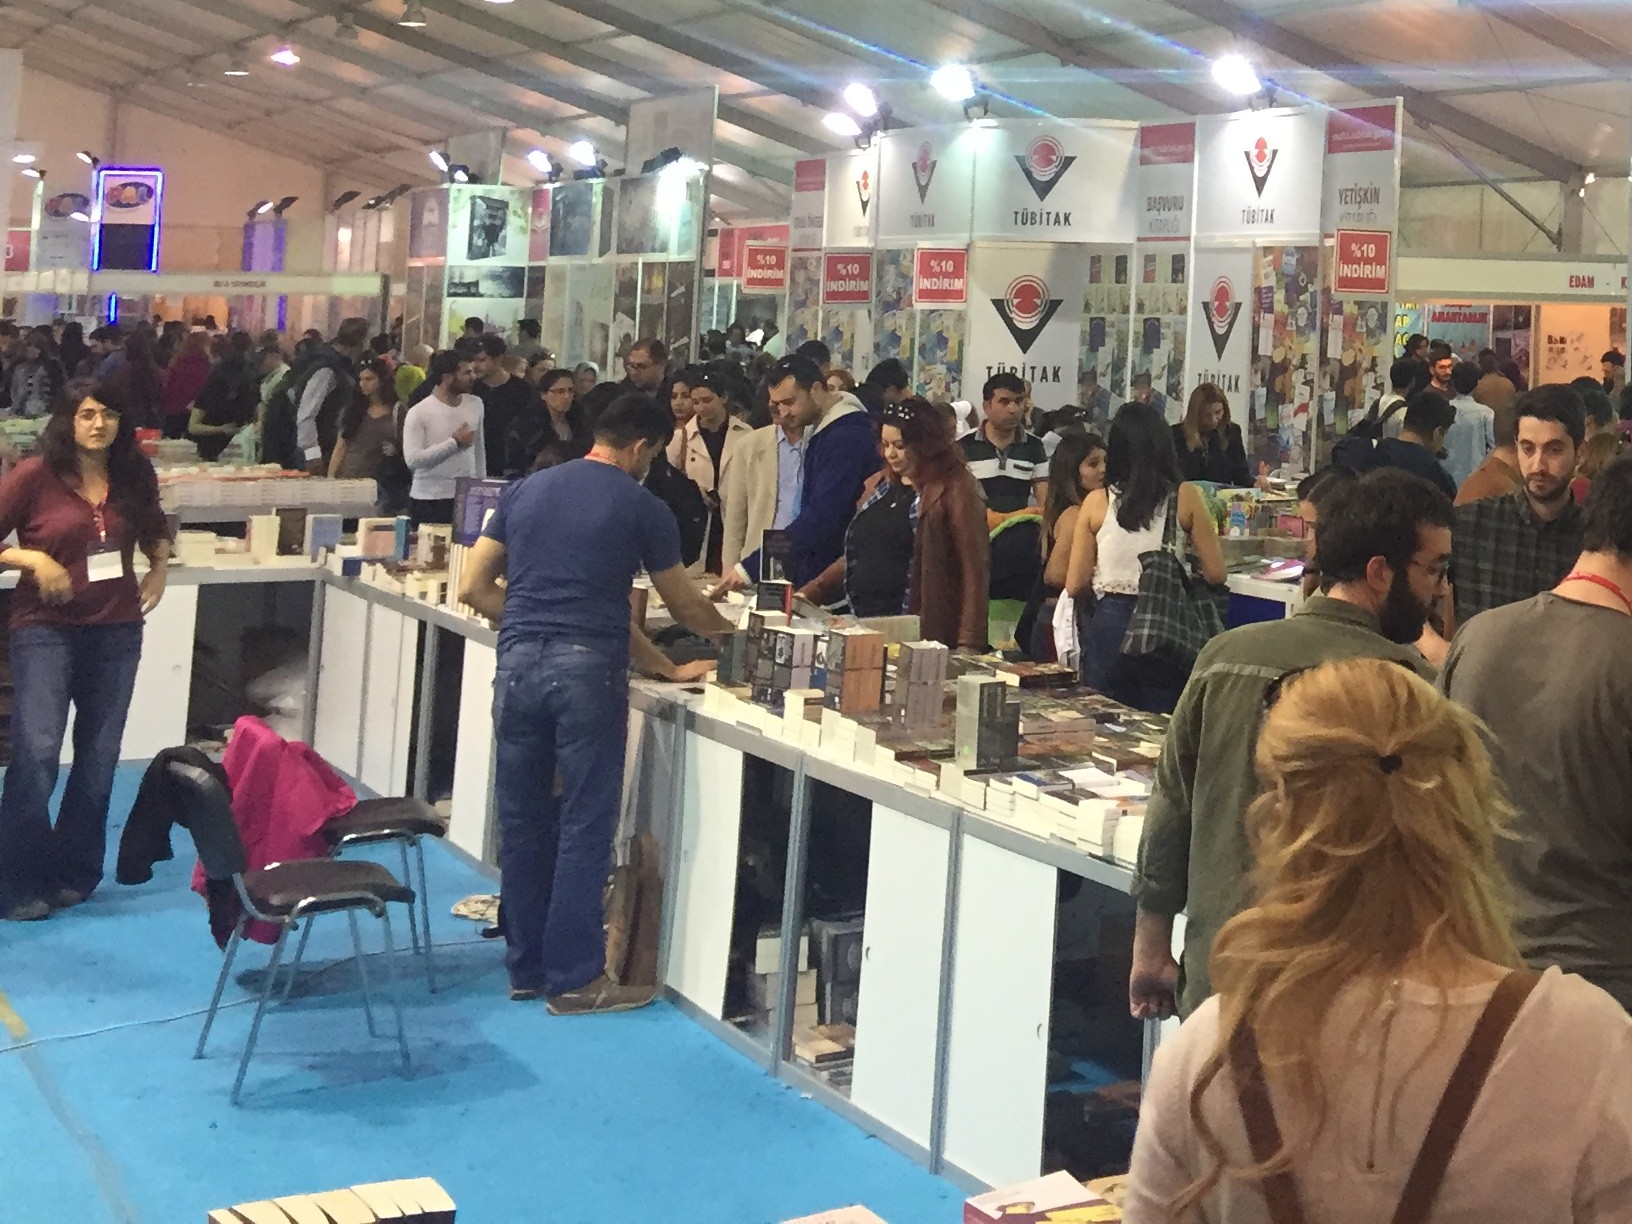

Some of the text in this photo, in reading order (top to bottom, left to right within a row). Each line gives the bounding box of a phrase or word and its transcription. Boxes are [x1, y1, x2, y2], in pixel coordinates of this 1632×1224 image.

[1013, 207, 1072, 226] TÜBİTAK
[1242, 206, 1275, 224] TÜBİTAK
[1351, 243, 1376, 258] %10
[836, 263, 860, 275] %10
[930, 259, 954, 273] %10
[1339, 261, 1386, 279] İNDİRİM
[919, 275, 964, 290] İNDİRİM
[1569, 275, 1594, 288] EDAM
